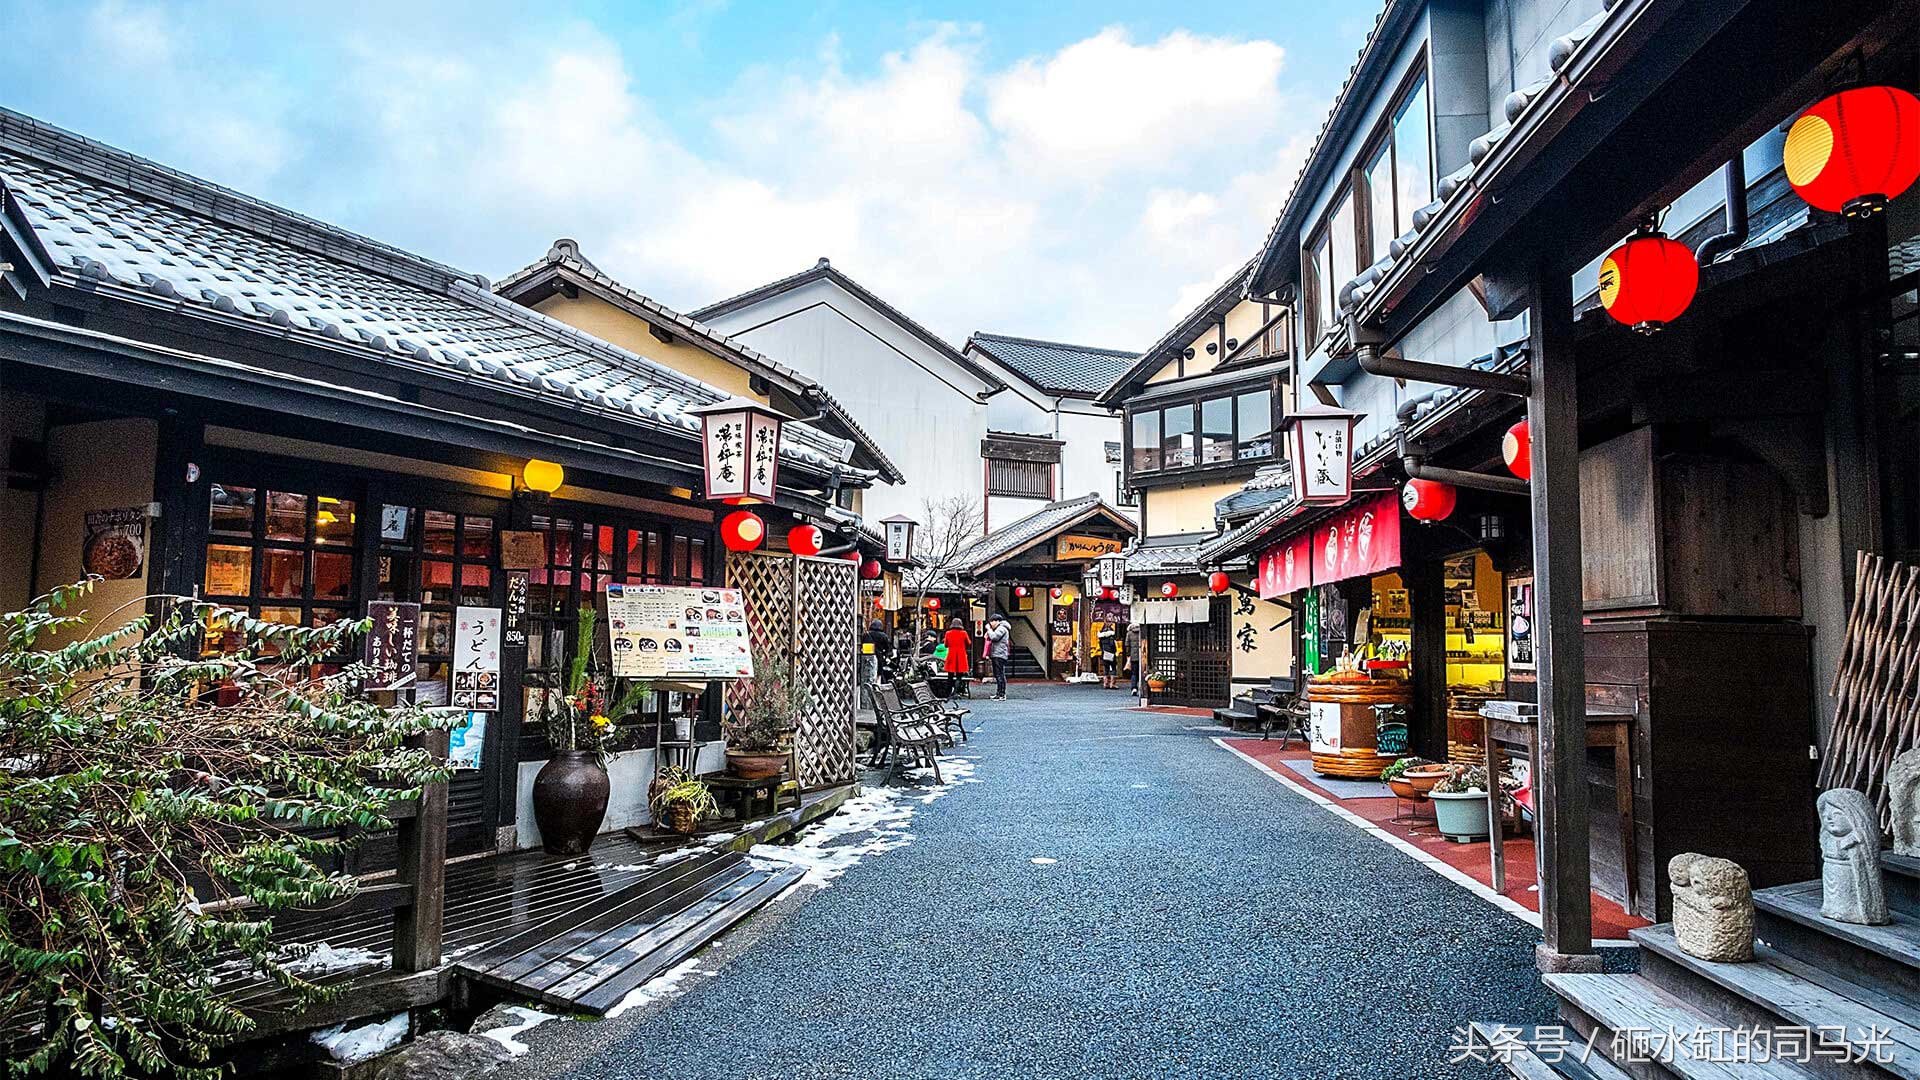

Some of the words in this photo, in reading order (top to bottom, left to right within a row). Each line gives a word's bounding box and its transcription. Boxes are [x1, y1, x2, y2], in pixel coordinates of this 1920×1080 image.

[1335, 429, 1343, 457] お漬け物
[508, 576, 520, 628] だんご汁
[383, 606, 400, 682] 美味しい珈琲
[401, 619, 414, 673] 一杯だての
[466, 620, 488, 670] うどん
